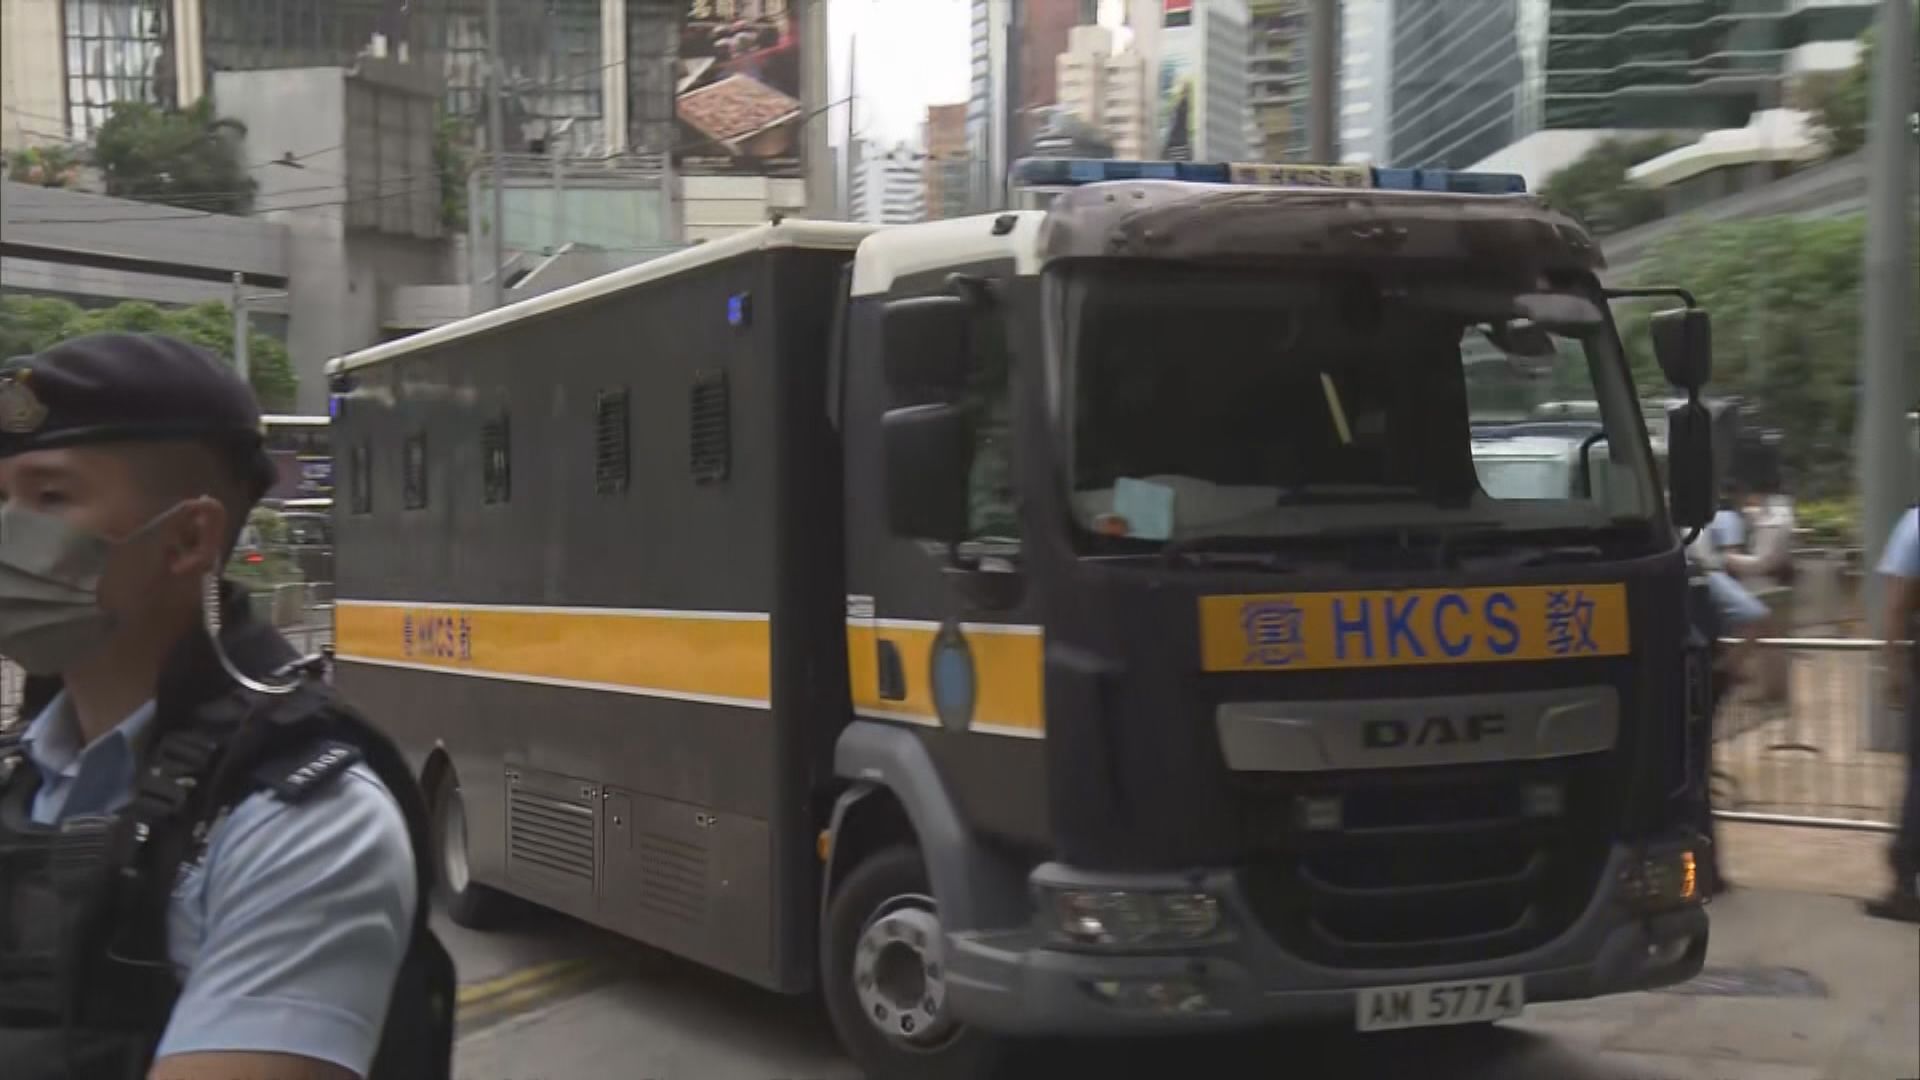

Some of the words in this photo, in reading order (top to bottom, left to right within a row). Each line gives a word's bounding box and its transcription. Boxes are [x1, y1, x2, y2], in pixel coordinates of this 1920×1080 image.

[1333, 593, 1521, 659] HKCS
[1361, 713, 1507, 748] DAF
[1370, 991, 1413, 1023] AM
[1428, 981, 1514, 1019] 5774
